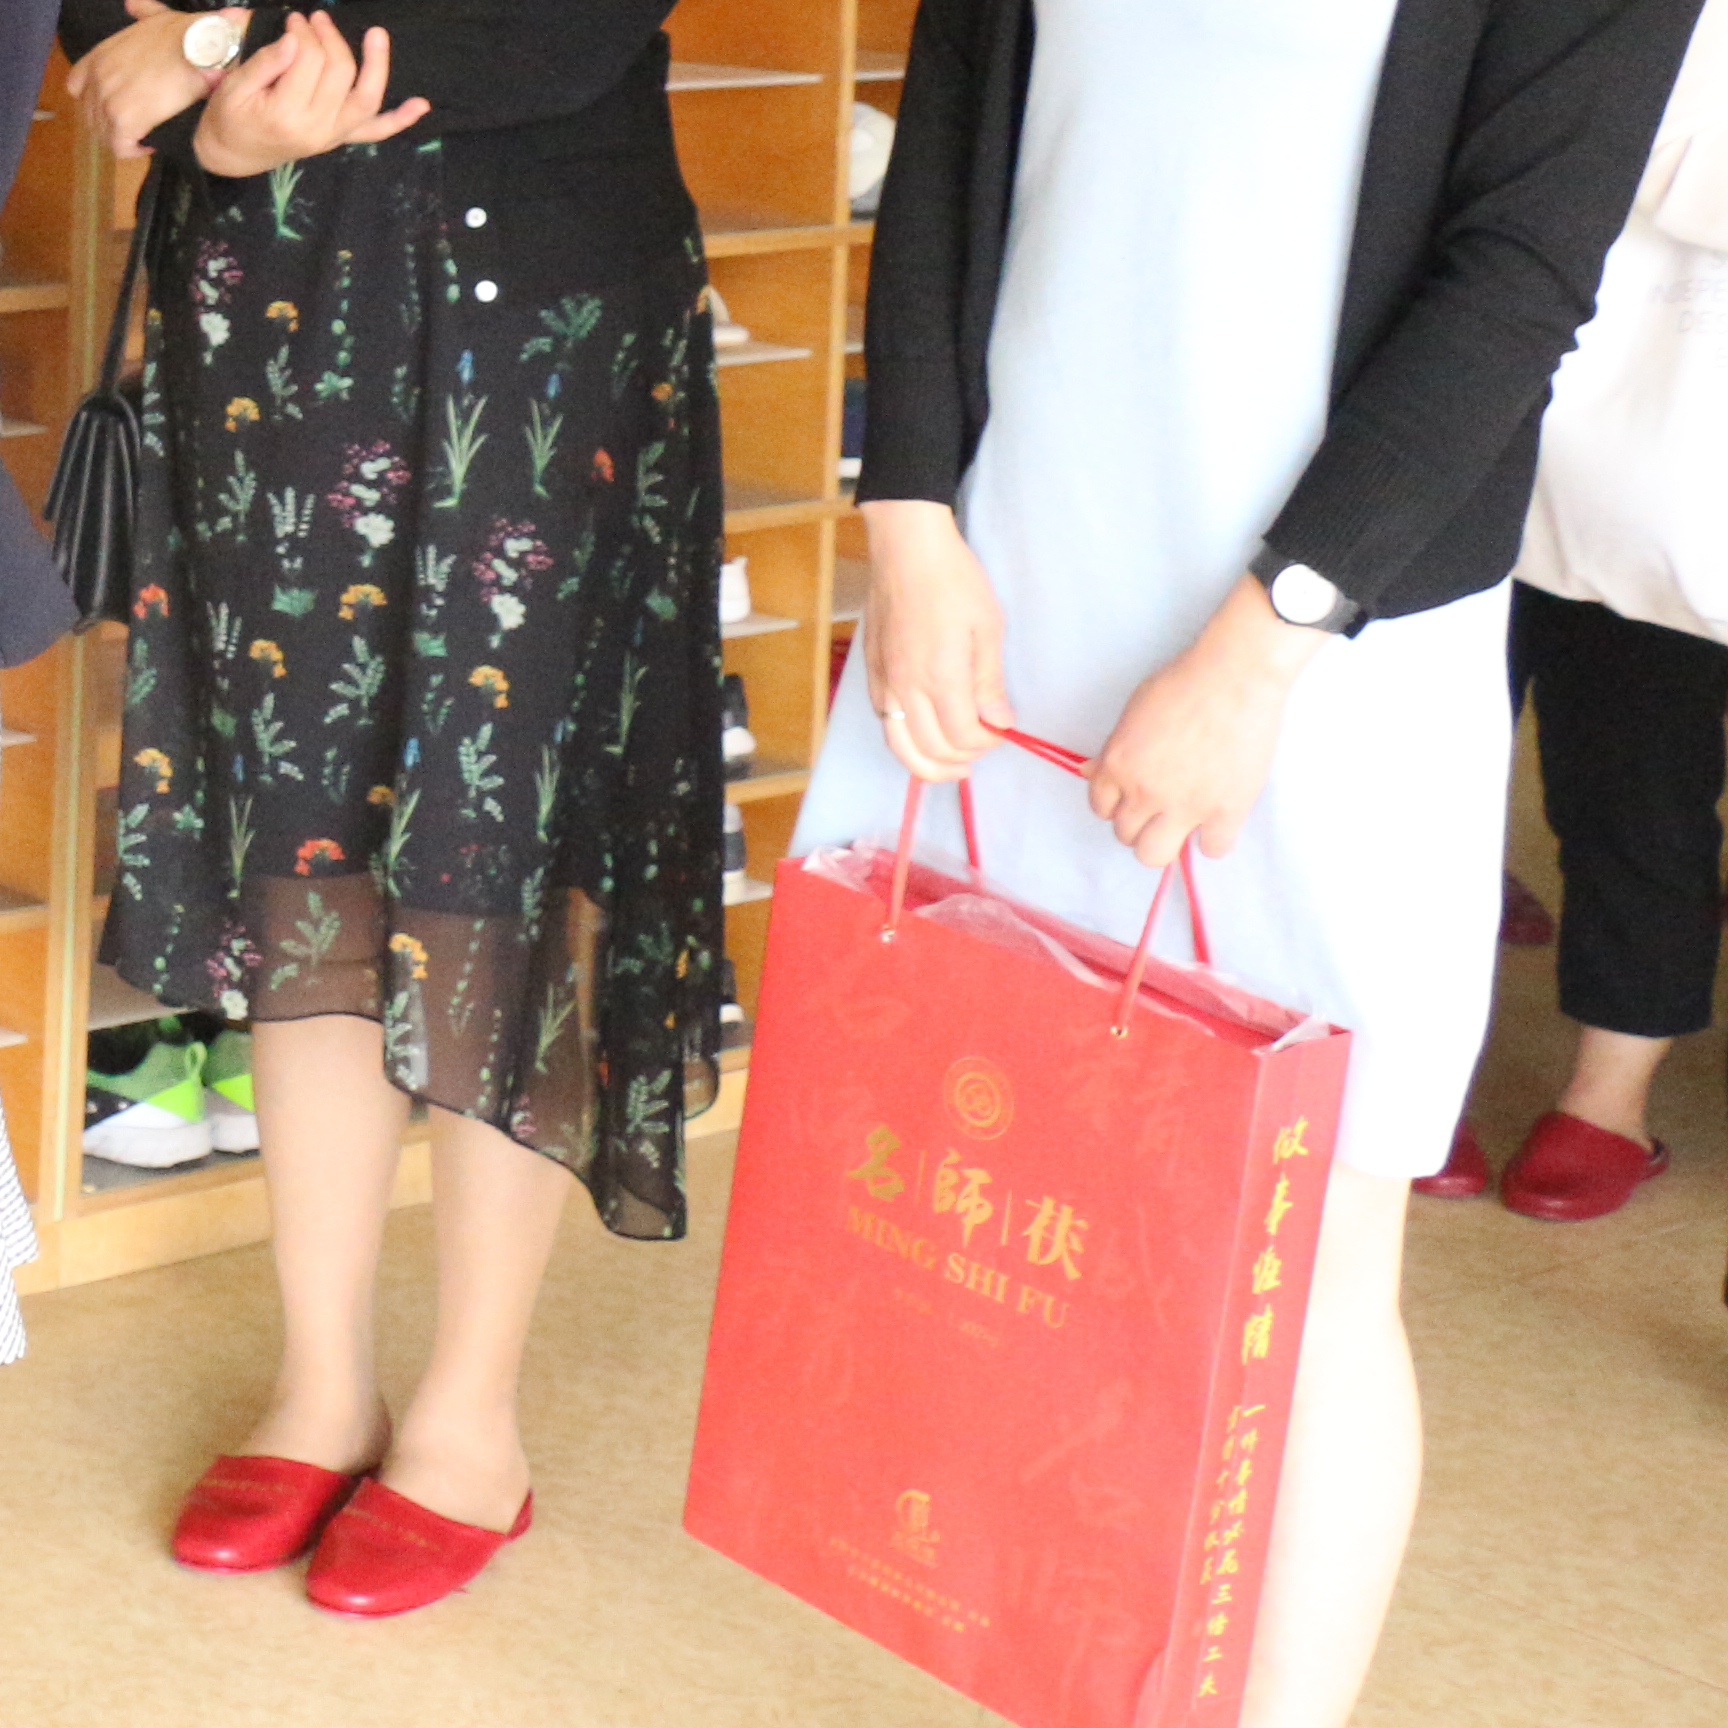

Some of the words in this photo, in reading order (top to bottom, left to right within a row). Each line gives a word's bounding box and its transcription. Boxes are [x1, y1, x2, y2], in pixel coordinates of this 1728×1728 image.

[846, 1206, 938, 1273] MING
[944, 1252, 1011, 1304] SHI
[1016, 1283, 1073, 1330] FU
